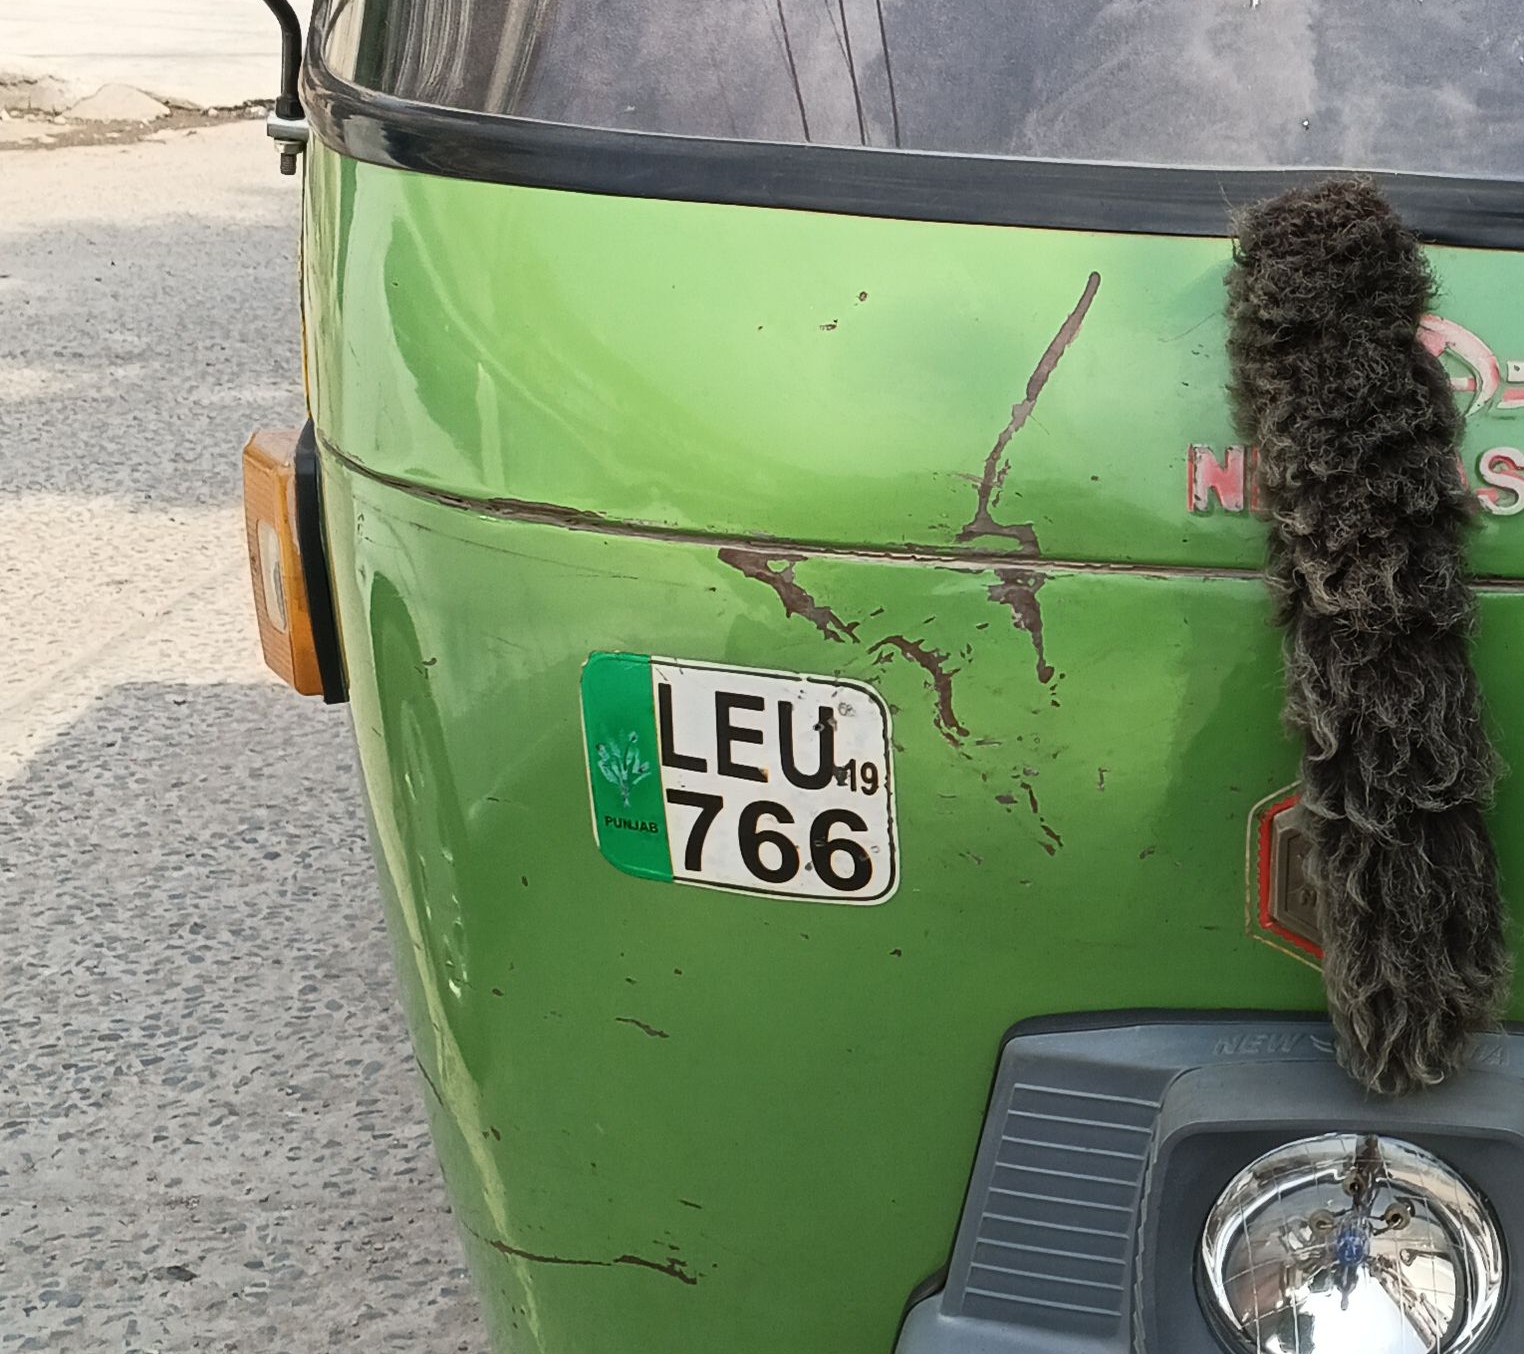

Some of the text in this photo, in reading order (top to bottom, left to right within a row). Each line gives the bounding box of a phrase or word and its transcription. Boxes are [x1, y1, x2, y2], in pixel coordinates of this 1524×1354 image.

[657, 682, 880, 797] LEU 19
[604, 814, 660, 834] PUNJAB
[665, 787, 874, 892] 766
[1213, 1032, 1303, 1056] NEW
